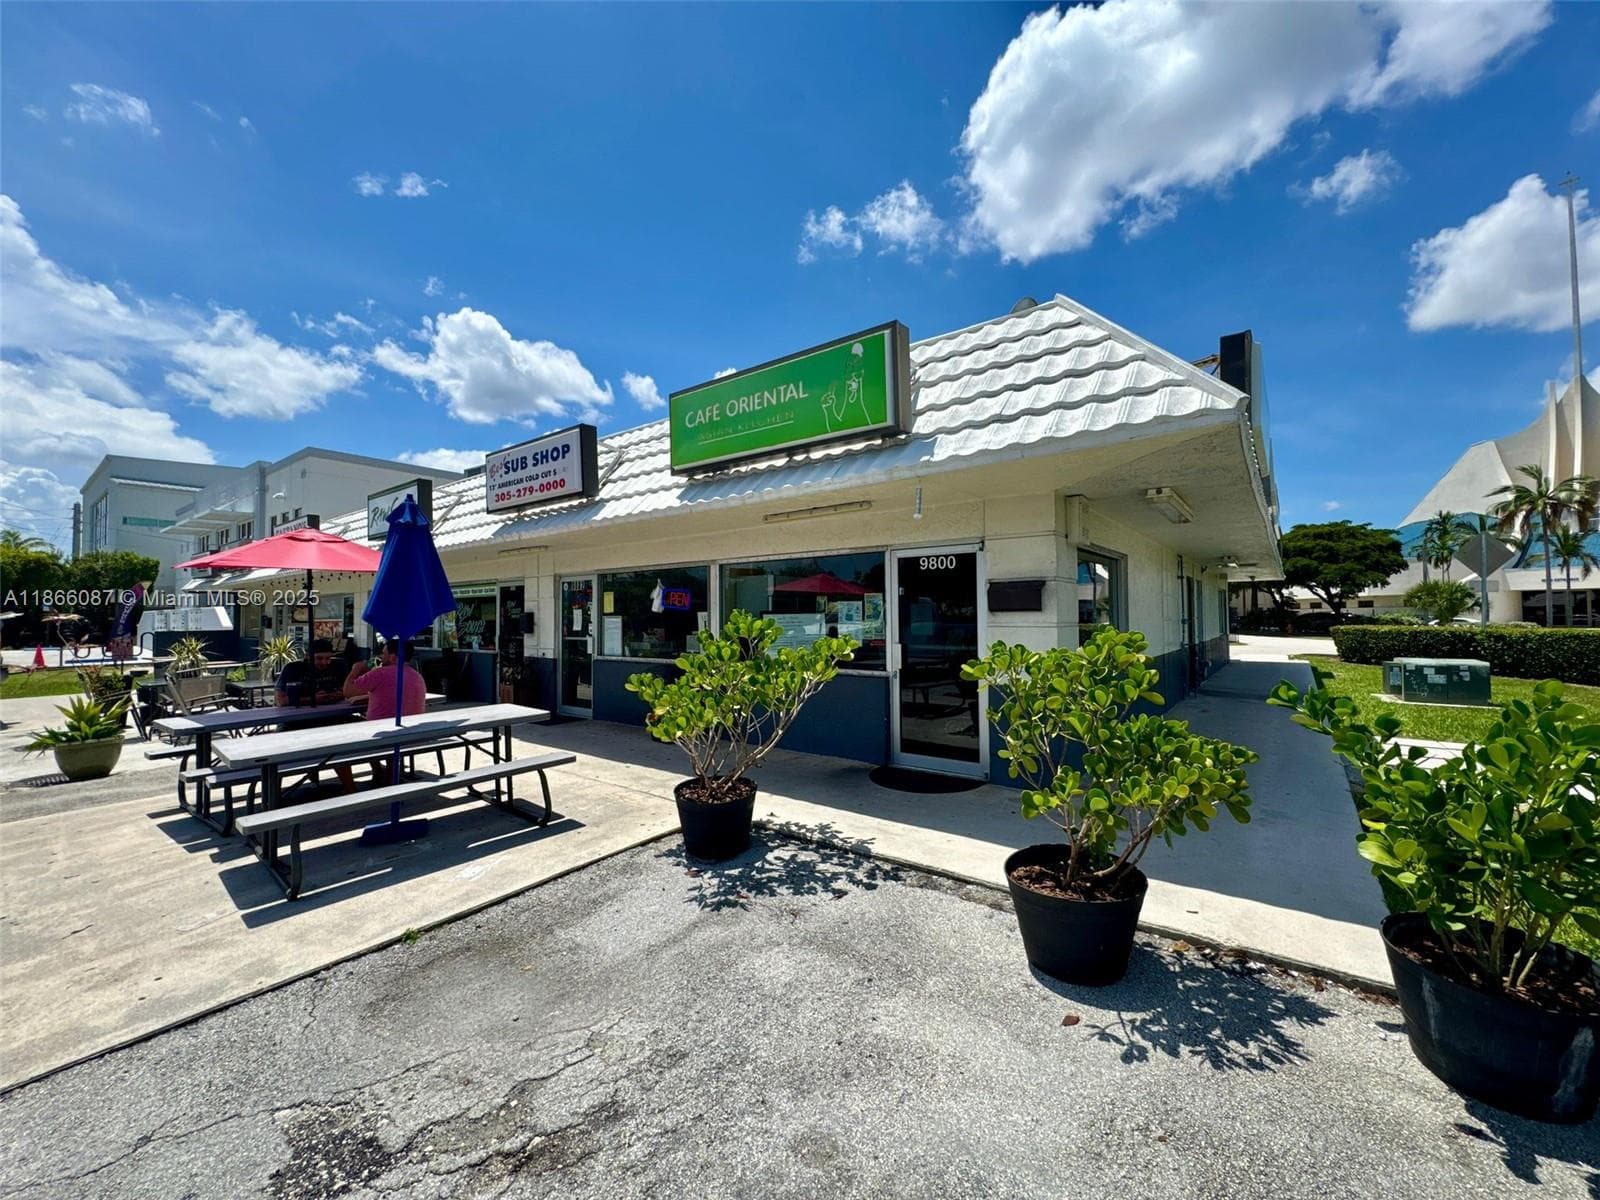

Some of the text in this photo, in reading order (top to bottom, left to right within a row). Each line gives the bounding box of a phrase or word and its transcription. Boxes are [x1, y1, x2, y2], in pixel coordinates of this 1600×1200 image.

[685, 380, 809, 428] CAFE ORIENTAL
[503, 455, 528, 475] SUB
[532, 443, 571, 467] SHOP
[495, 478, 566, 503] 305-279-0000
[497, 477, 524, 489] AMERICAN
[525, 473, 540, 483] COLD
[919, 555, 956, 570] 9800
[666, 591, 689, 607] PEN
